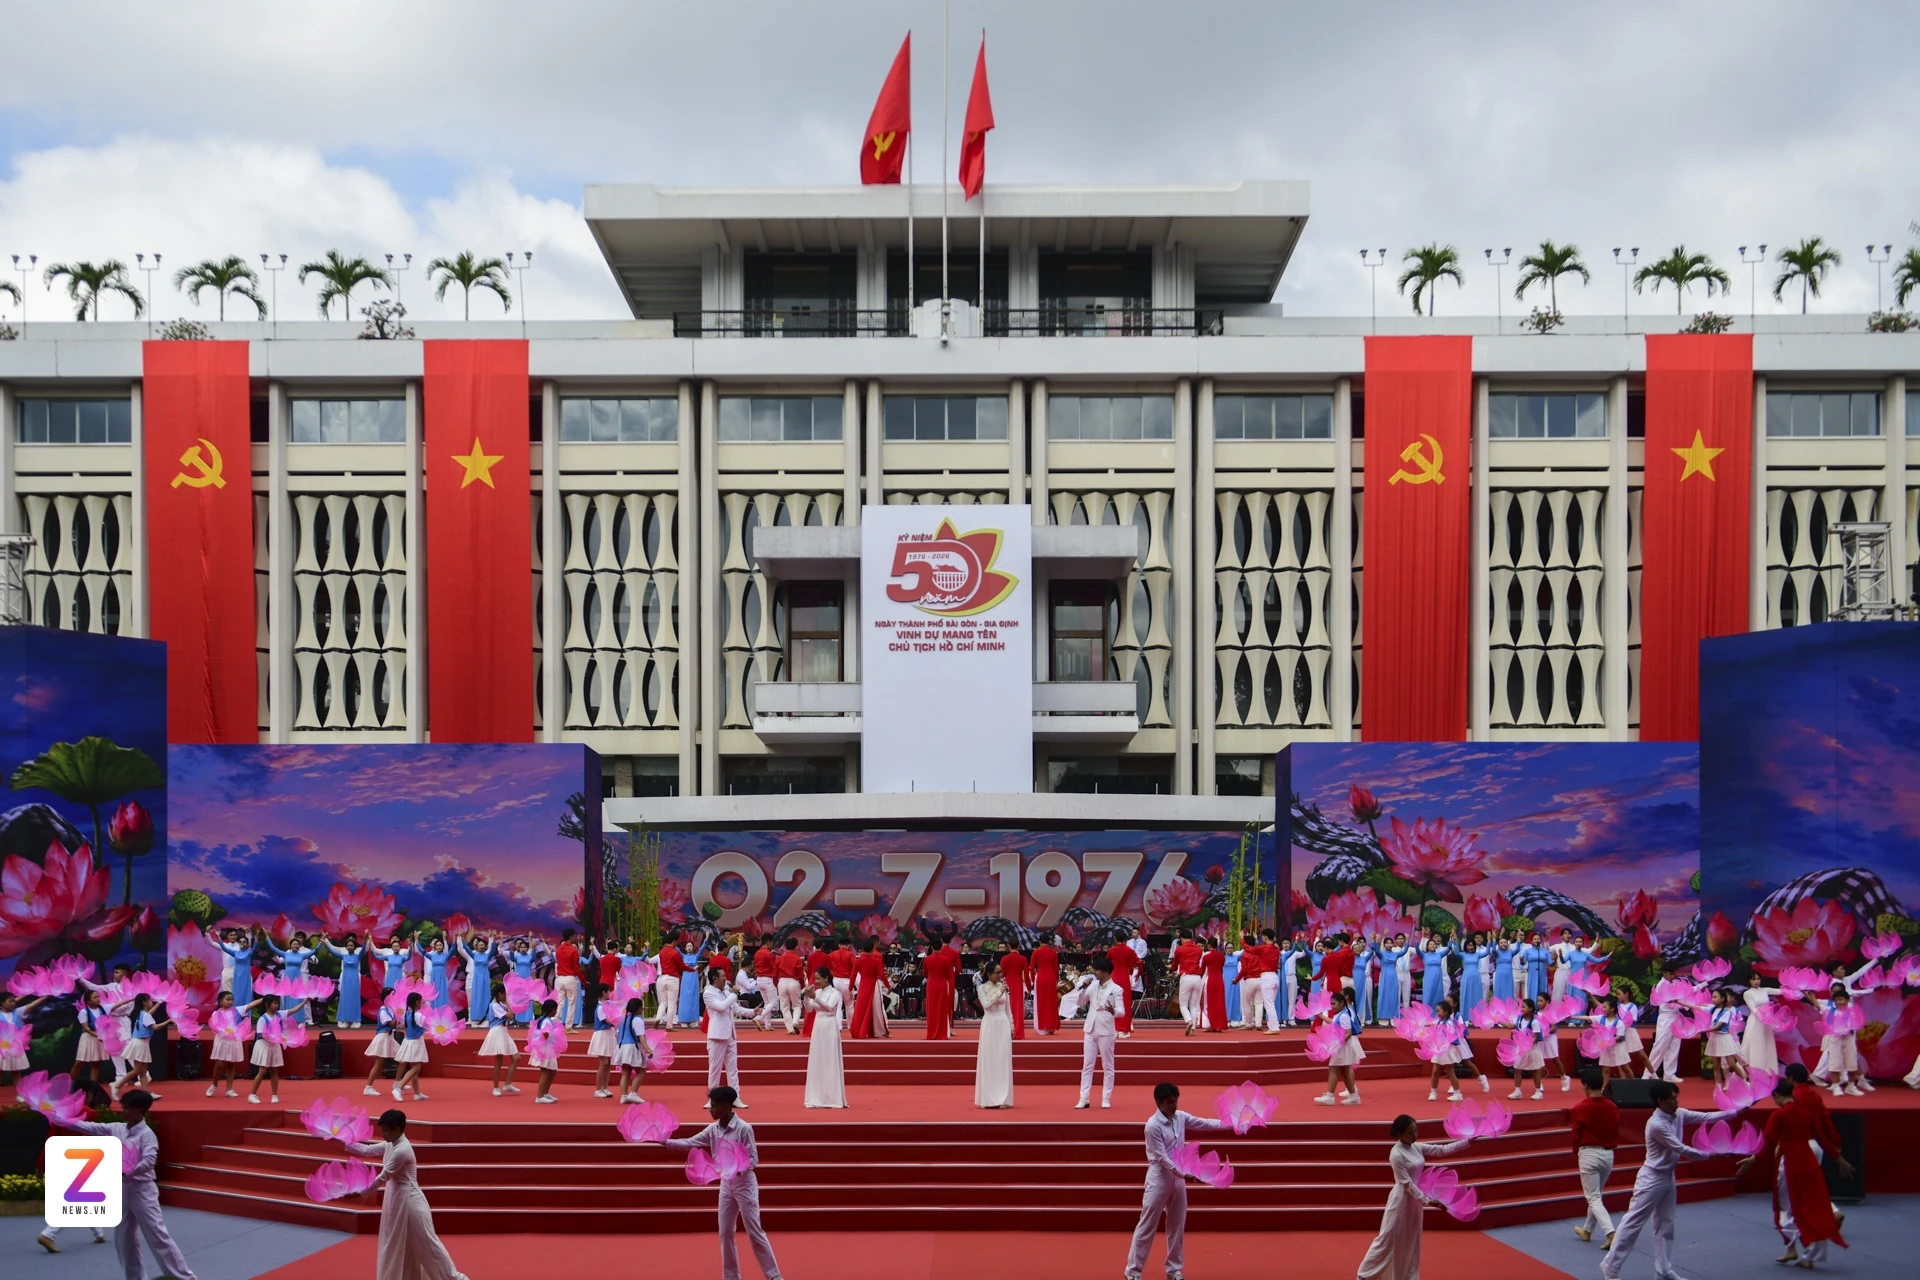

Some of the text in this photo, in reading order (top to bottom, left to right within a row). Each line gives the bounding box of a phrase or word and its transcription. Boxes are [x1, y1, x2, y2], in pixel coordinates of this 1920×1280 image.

[898, 533, 933, 542] KỲ NIỆM
[886, 542, 980, 603] 50
[920, 593, 966, 606] năm
[875, 619, 896, 628] NGÀY
[899, 619, 926, 628] THÀNH
[928, 618, 943, 628] PHỐ
[946, 620, 958, 628] SÀI
[961, 620, 977, 628] GÒN
[999, 620, 1019, 628] ĐỊNH
[897, 629, 997, 640] VINH DỰ MANG TÊN
[889, 640, 1005, 653] CHỦ TỊCH HỒ CHÍ MINH
[691, 850, 1192, 929] 02-7-1976
